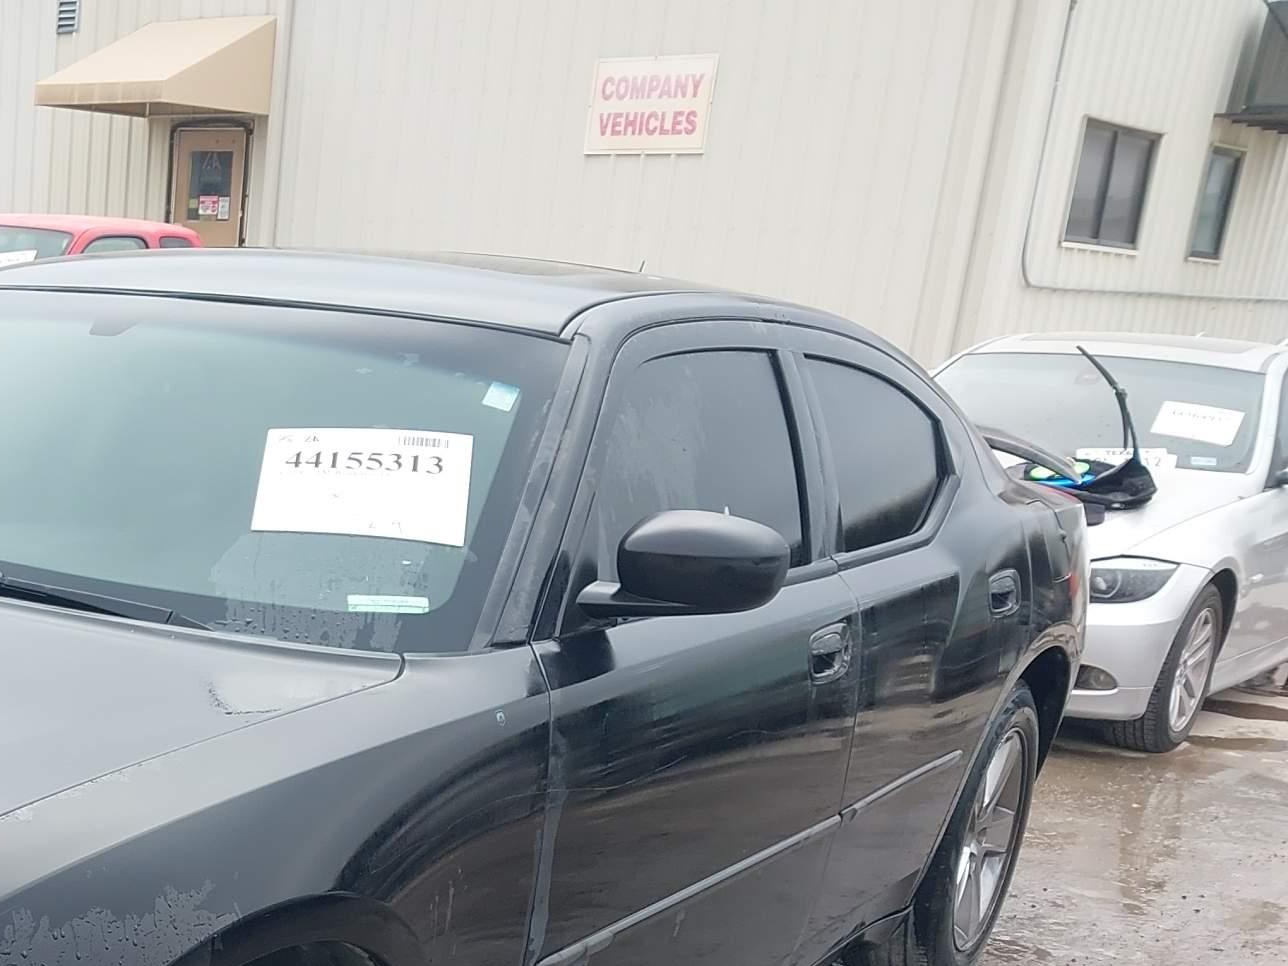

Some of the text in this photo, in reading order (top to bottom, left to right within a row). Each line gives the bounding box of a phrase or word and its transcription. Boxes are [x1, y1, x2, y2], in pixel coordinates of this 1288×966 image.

[601, 73, 705, 101] COMPANY
[599, 110, 698, 136] VEHICLES
[285, 451, 444, 475] 44155313
